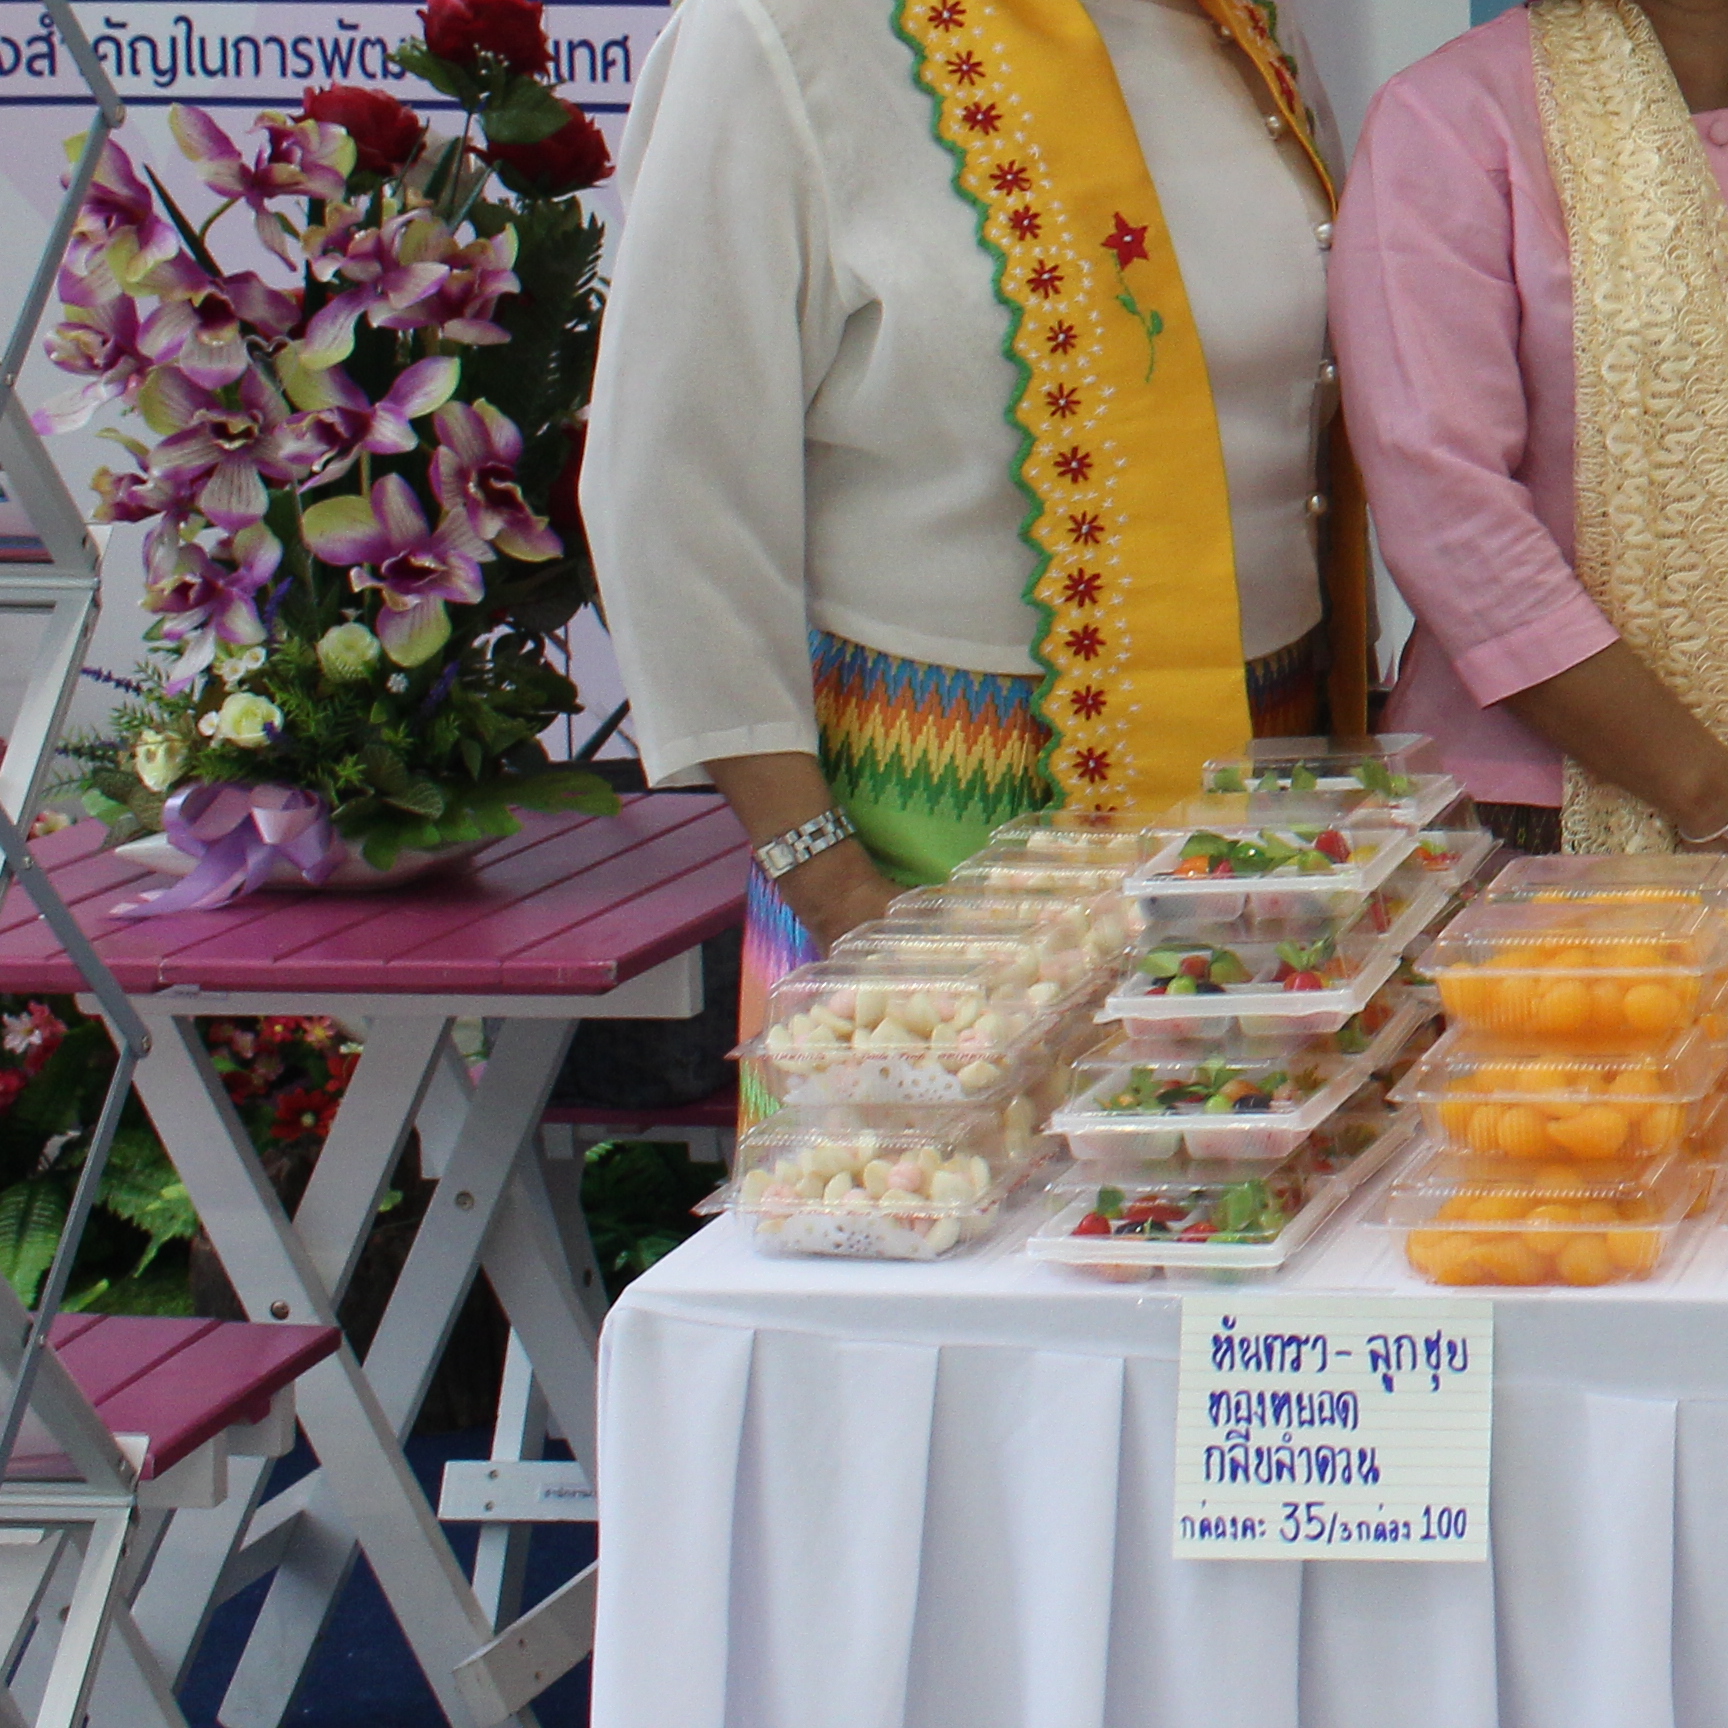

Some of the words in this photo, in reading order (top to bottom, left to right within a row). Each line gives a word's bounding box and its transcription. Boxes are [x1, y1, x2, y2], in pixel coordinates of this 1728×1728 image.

[1208, 1389, 1359, 1432] ทองหยอด
[1419, 1504, 1468, 1541] 100
